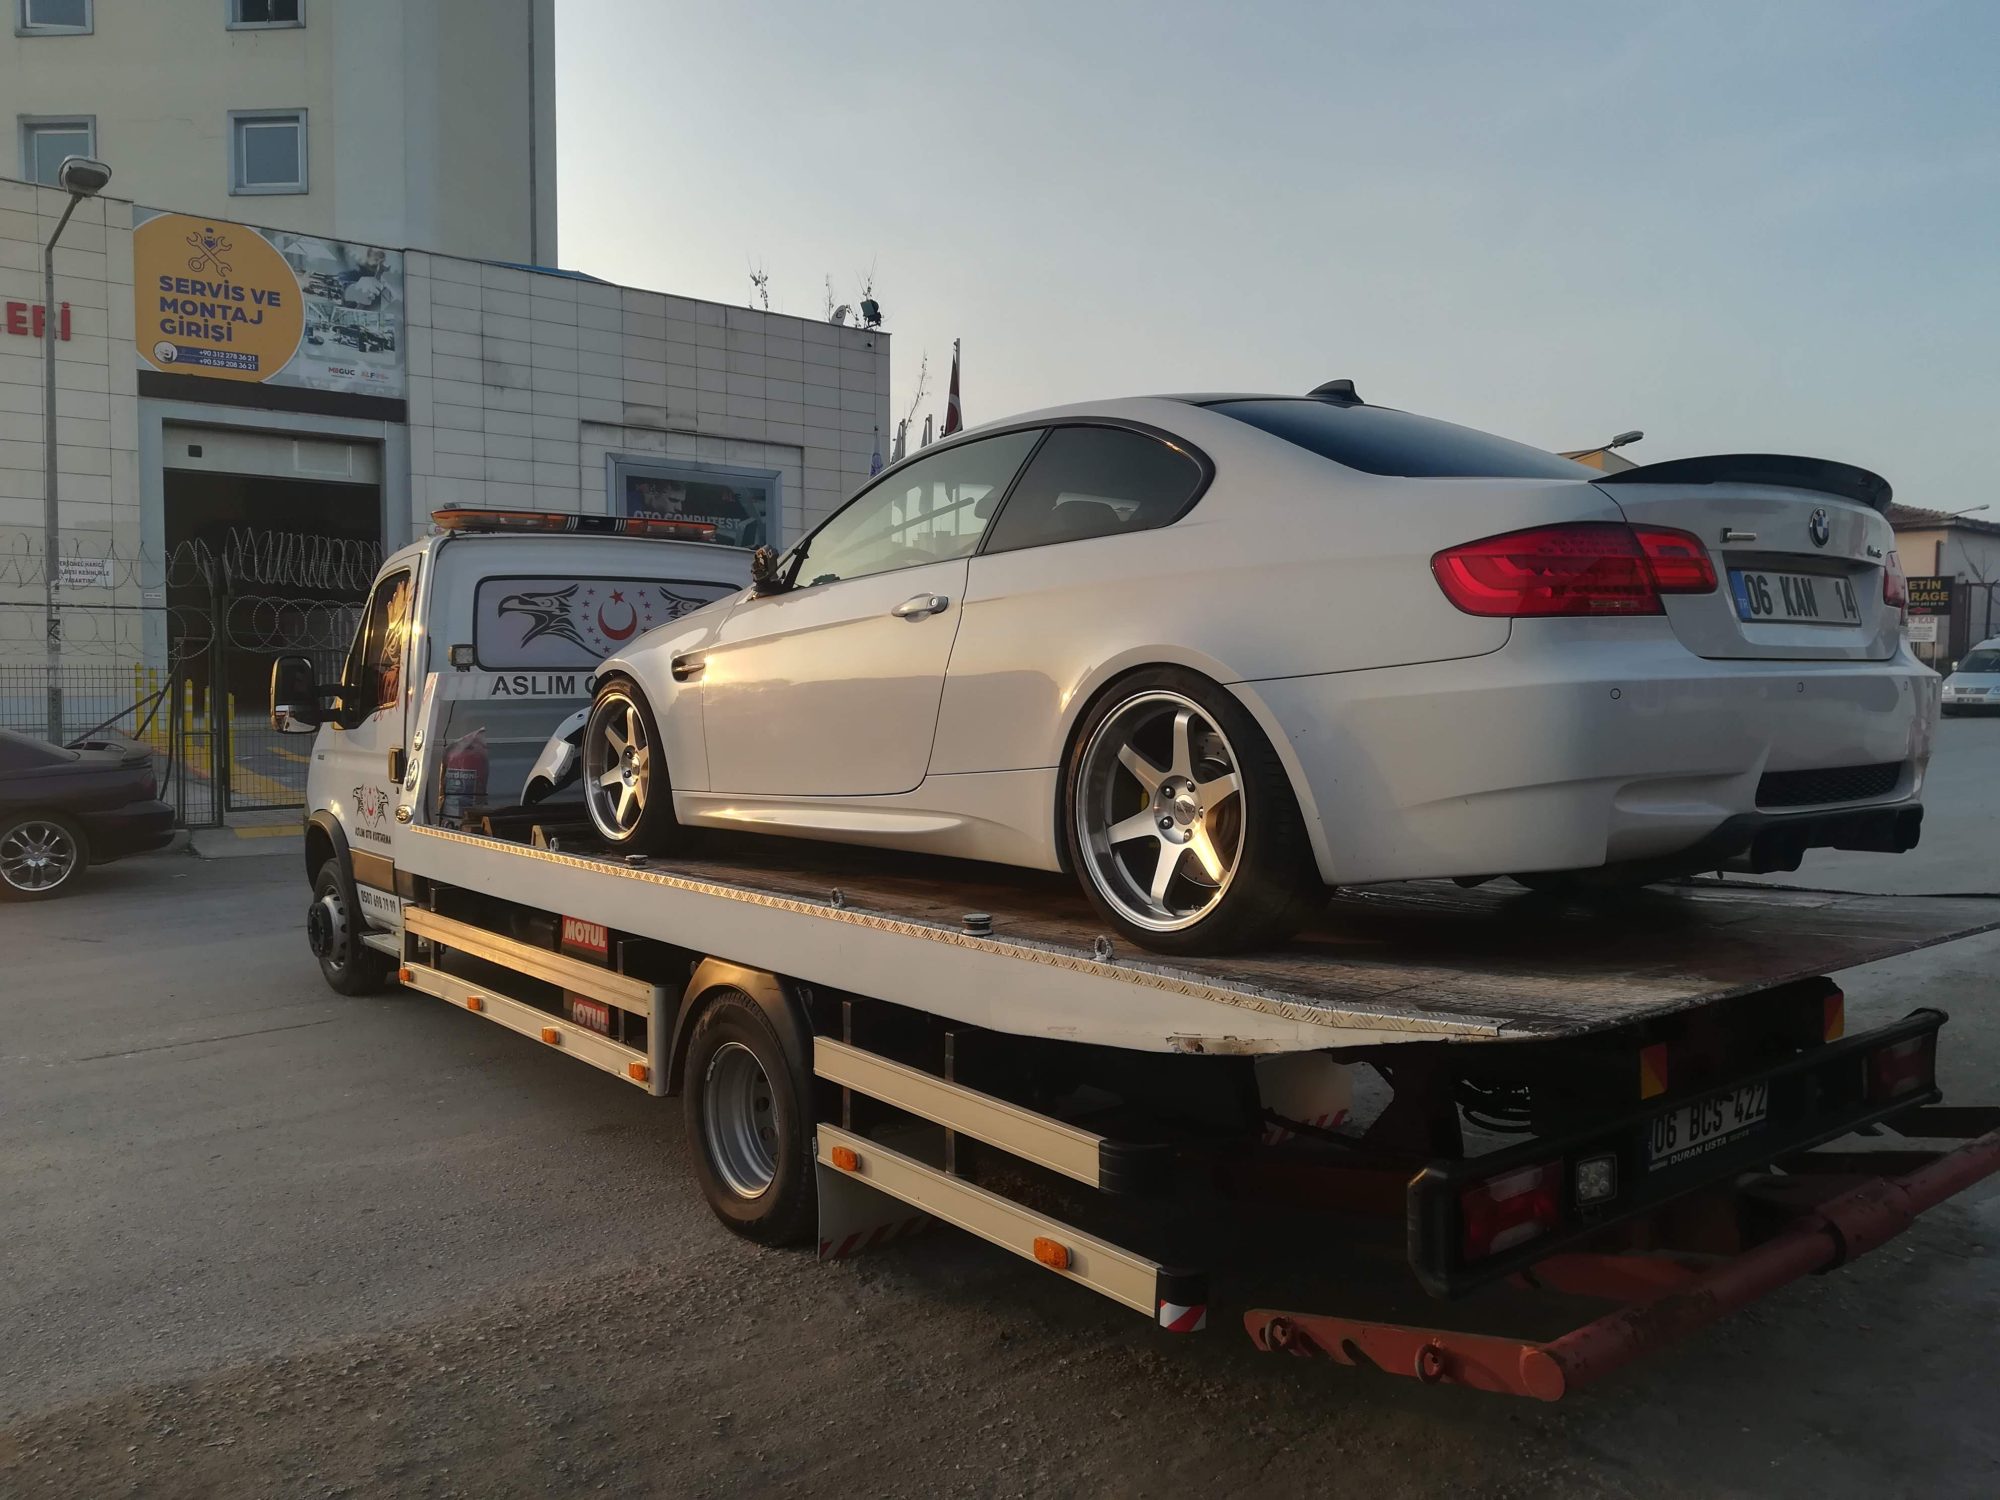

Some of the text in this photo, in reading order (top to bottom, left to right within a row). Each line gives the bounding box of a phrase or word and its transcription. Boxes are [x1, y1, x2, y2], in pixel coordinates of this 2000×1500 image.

[160, 275, 281, 307] SERVİS VE
[0, 302, 71, 341] ERİ
[160, 296, 263, 325] MONTAJ
[160, 315, 232, 342] GİRİŞİ
[225, 352, 238, 360] 278
[1744, 574, 1857, 619] 06 KAN 14
[1909, 578, 1942, 590] ETİN
[1911, 590, 1949, 601] RAGE
[491, 675, 575, 696] ASLIM
[564, 919, 606, 947] MOTUL
[1654, 1084, 1766, 1153] 06 BCS 422
[1670, 1144, 1703, 1165] DURAN
[1704, 1136, 1727, 1151] USTA
